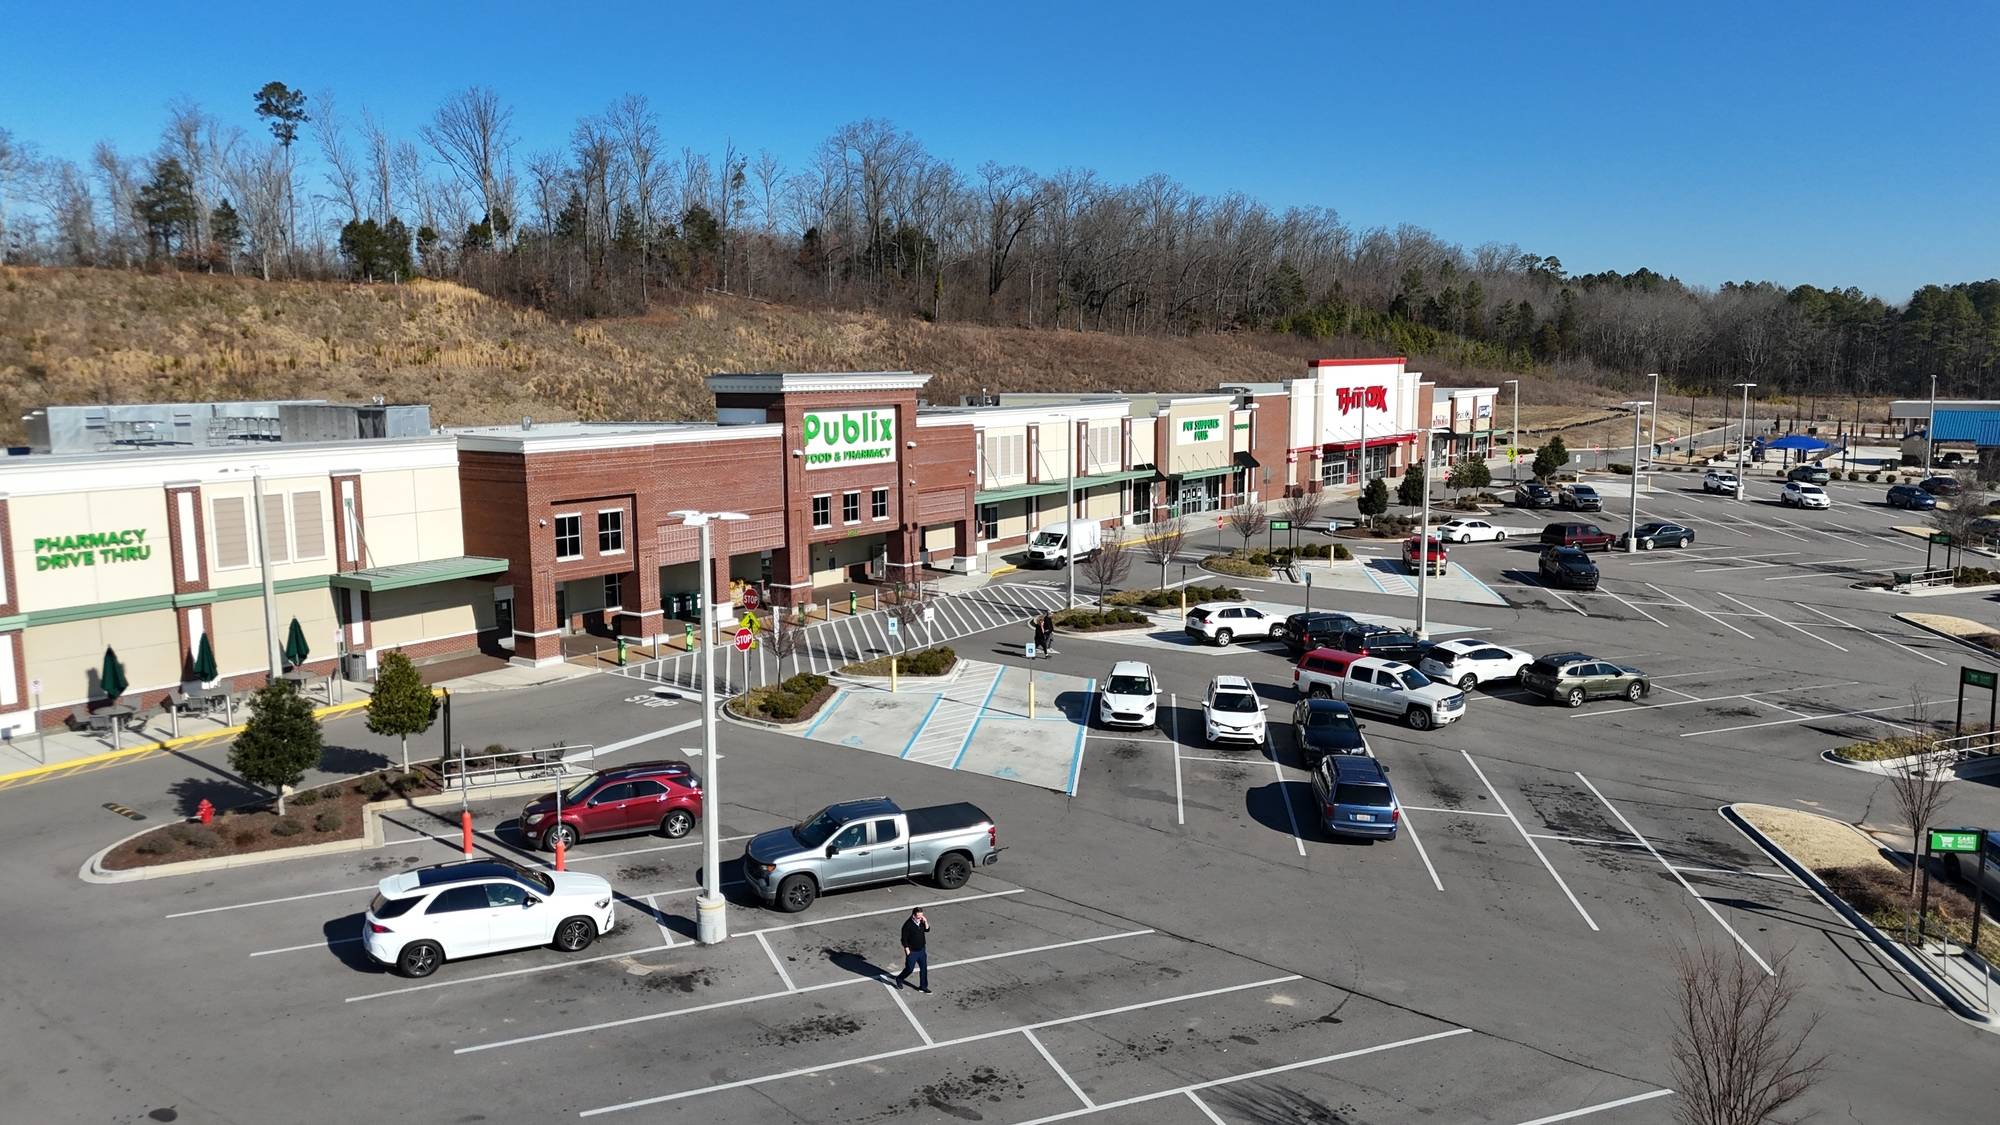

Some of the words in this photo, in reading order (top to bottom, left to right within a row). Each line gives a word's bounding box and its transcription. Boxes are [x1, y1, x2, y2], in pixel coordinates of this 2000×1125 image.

[803, 411, 893, 447] Publix
[804, 453, 832, 465] FOOD
[834, 452, 842, 462] &
[843, 447, 892, 461] PHARMACY
[33, 528, 147, 554] PHARMACY
[36, 550, 95, 571] DRIVE
[99, 545, 151, 564] THRU
[743, 595, 758, 604] STOP
[736, 633, 752, 645] STOP
